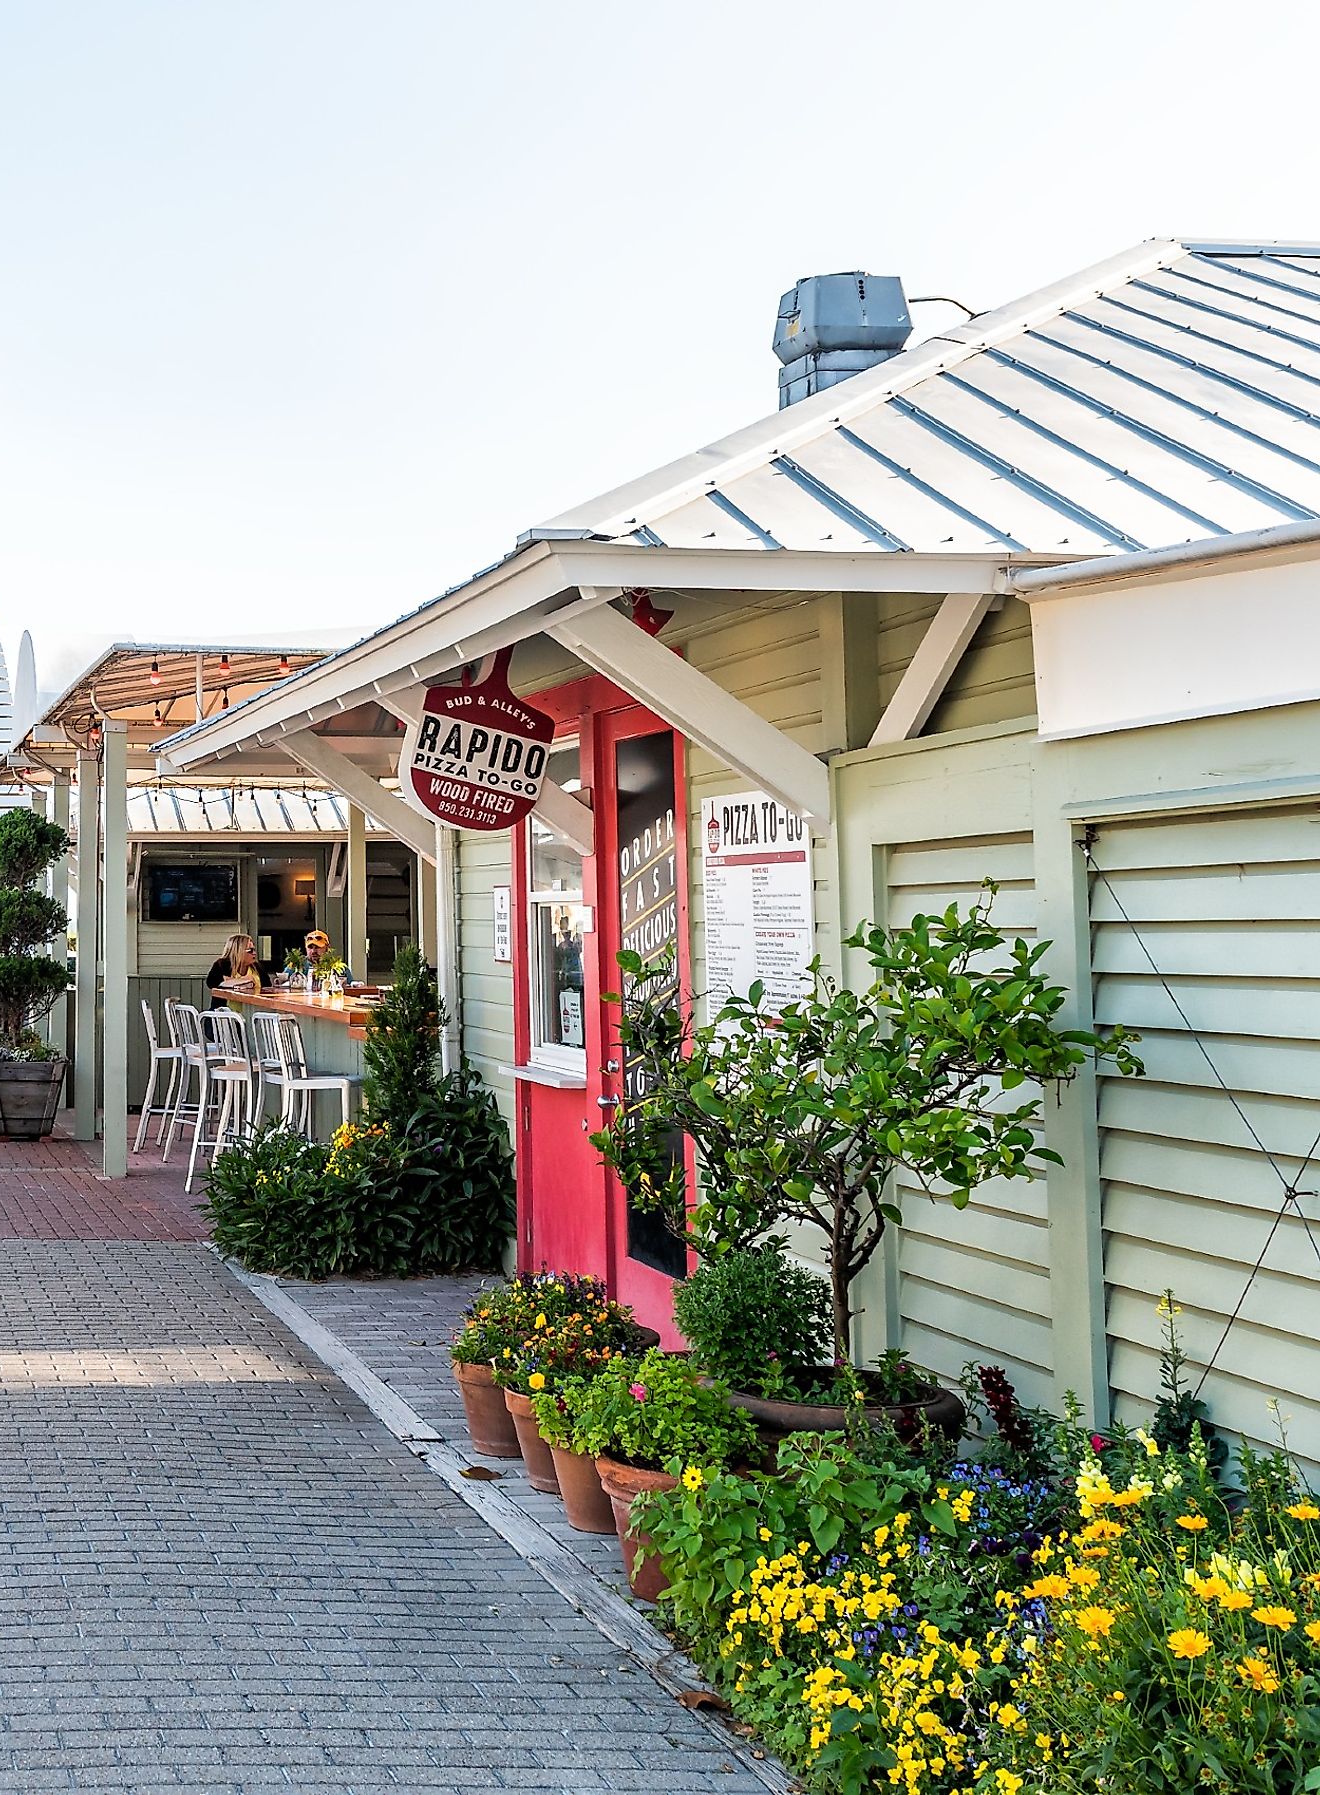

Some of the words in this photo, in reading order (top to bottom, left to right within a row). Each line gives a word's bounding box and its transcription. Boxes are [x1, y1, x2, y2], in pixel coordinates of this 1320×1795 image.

[445, 695, 473, 709] BUD
[477, 695, 486, 706] &
[491, 699, 536, 730] ALLEY'S
[418, 715, 546, 779] RAPIDO
[414, 753, 468, 778] PIZZA
[478, 769, 537, 795] TO-GO
[430, 778, 470, 802] WOOD
[473, 790, 514, 814] FIRED
[439, 801, 497, 824] 850.231.3113
[622, 809, 674, 876] ORDER
[724, 804, 758, 845] PIZZA
[762, 802, 802, 842] TO-GO
[623, 855, 675, 922] FAST
